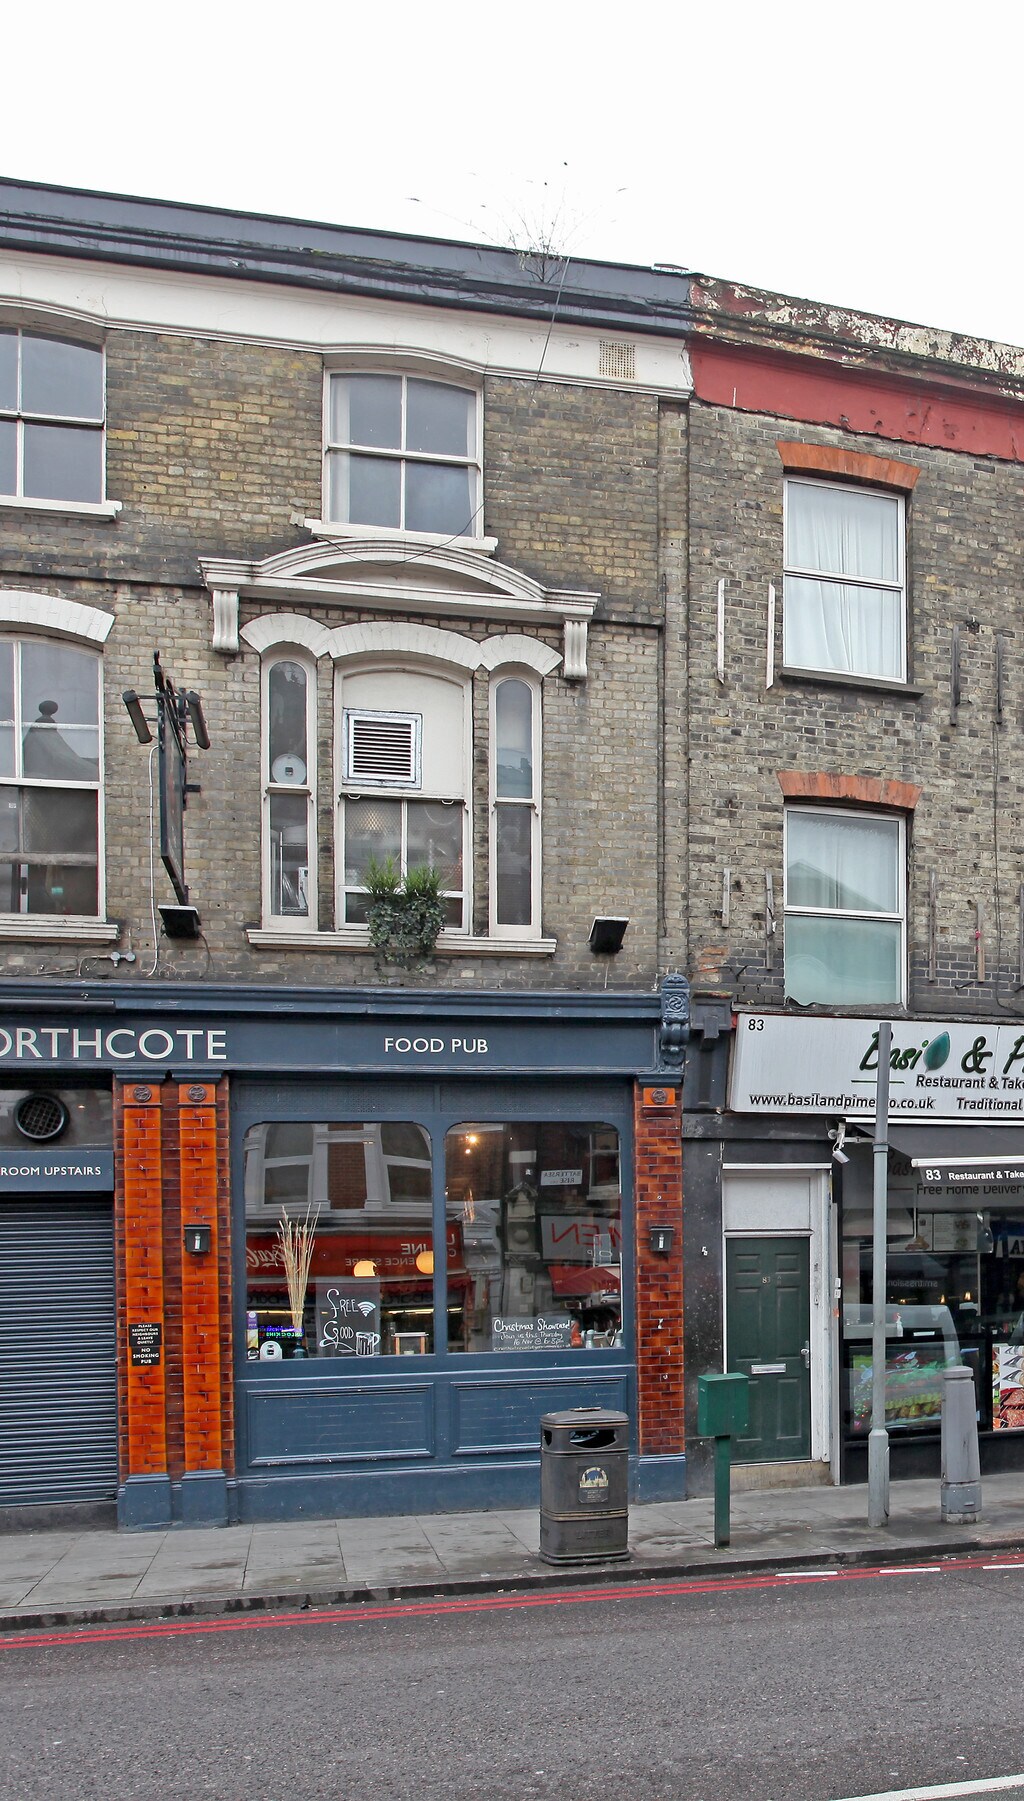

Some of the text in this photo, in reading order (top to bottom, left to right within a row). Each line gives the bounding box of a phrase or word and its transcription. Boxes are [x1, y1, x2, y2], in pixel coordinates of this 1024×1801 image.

[748, 1018, 765, 1032] 83
[384, 1037, 489, 1054] FOOD PUB
[961, 1036, 993, 1074] &
[916, 1074, 986, 1090] Restaurant
[989, 1078, 999, 1091] &
[749, 1093, 935, 1111] www.basilandpimeo.co.uk
[957, 1097, 1022, 1112] Traditional
[1, 1166, 102, 1176] ROOM UPSTAIRS
[925, 1169, 942, 1181] 83
[948, 1171, 995, 1181] Restaurant
[996, 1170, 1003, 1180] &
[1004, 1170, 1024, 1180] Take
[916, 1184, 943, 1195] Free
[947, 1185, 979, 1195] Home
[493, 1318, 534, 1333] Christmas
